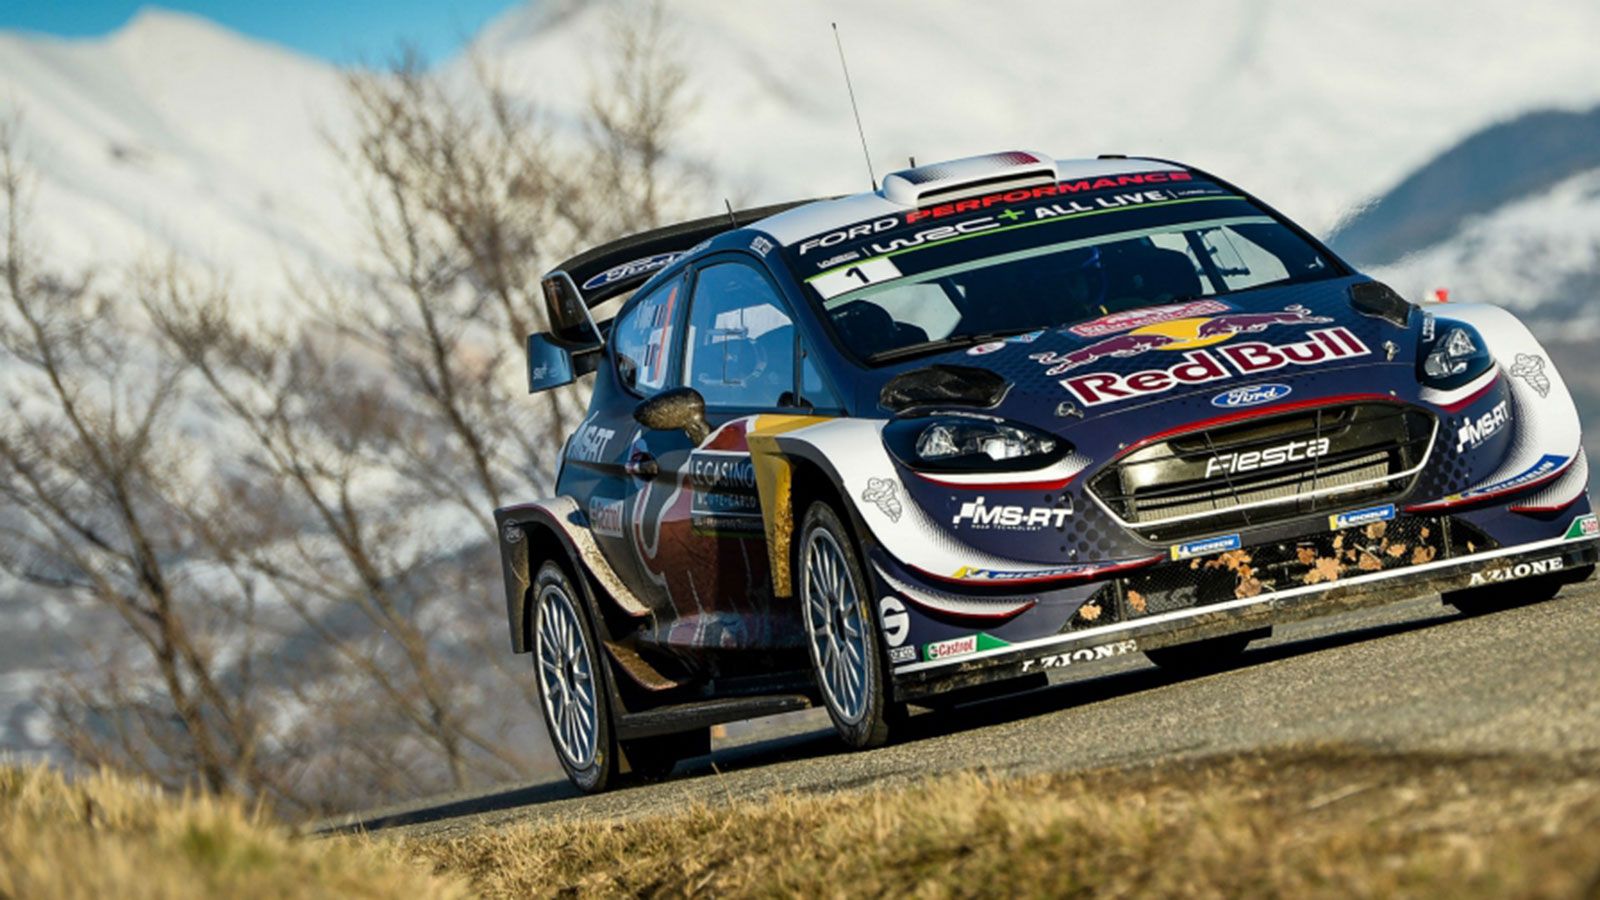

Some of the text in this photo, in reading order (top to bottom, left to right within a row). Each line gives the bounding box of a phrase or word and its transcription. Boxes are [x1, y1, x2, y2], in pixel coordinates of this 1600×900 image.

[800, 217, 899, 255] FORD
[906, 171, 1192, 224] PERFORMANCE
[1034, 200, 1094, 219] ALL
[1096, 189, 1169, 208] LIVE
[845, 266, 871, 284] 1
[1062, 328, 1368, 405] Red Bull
[1226, 385, 1279, 405] Ford
[1204, 438, 1330, 479] Fiesta
[1467, 556, 1564, 586] AZIONE
[938, 638, 973, 657] Castrol
